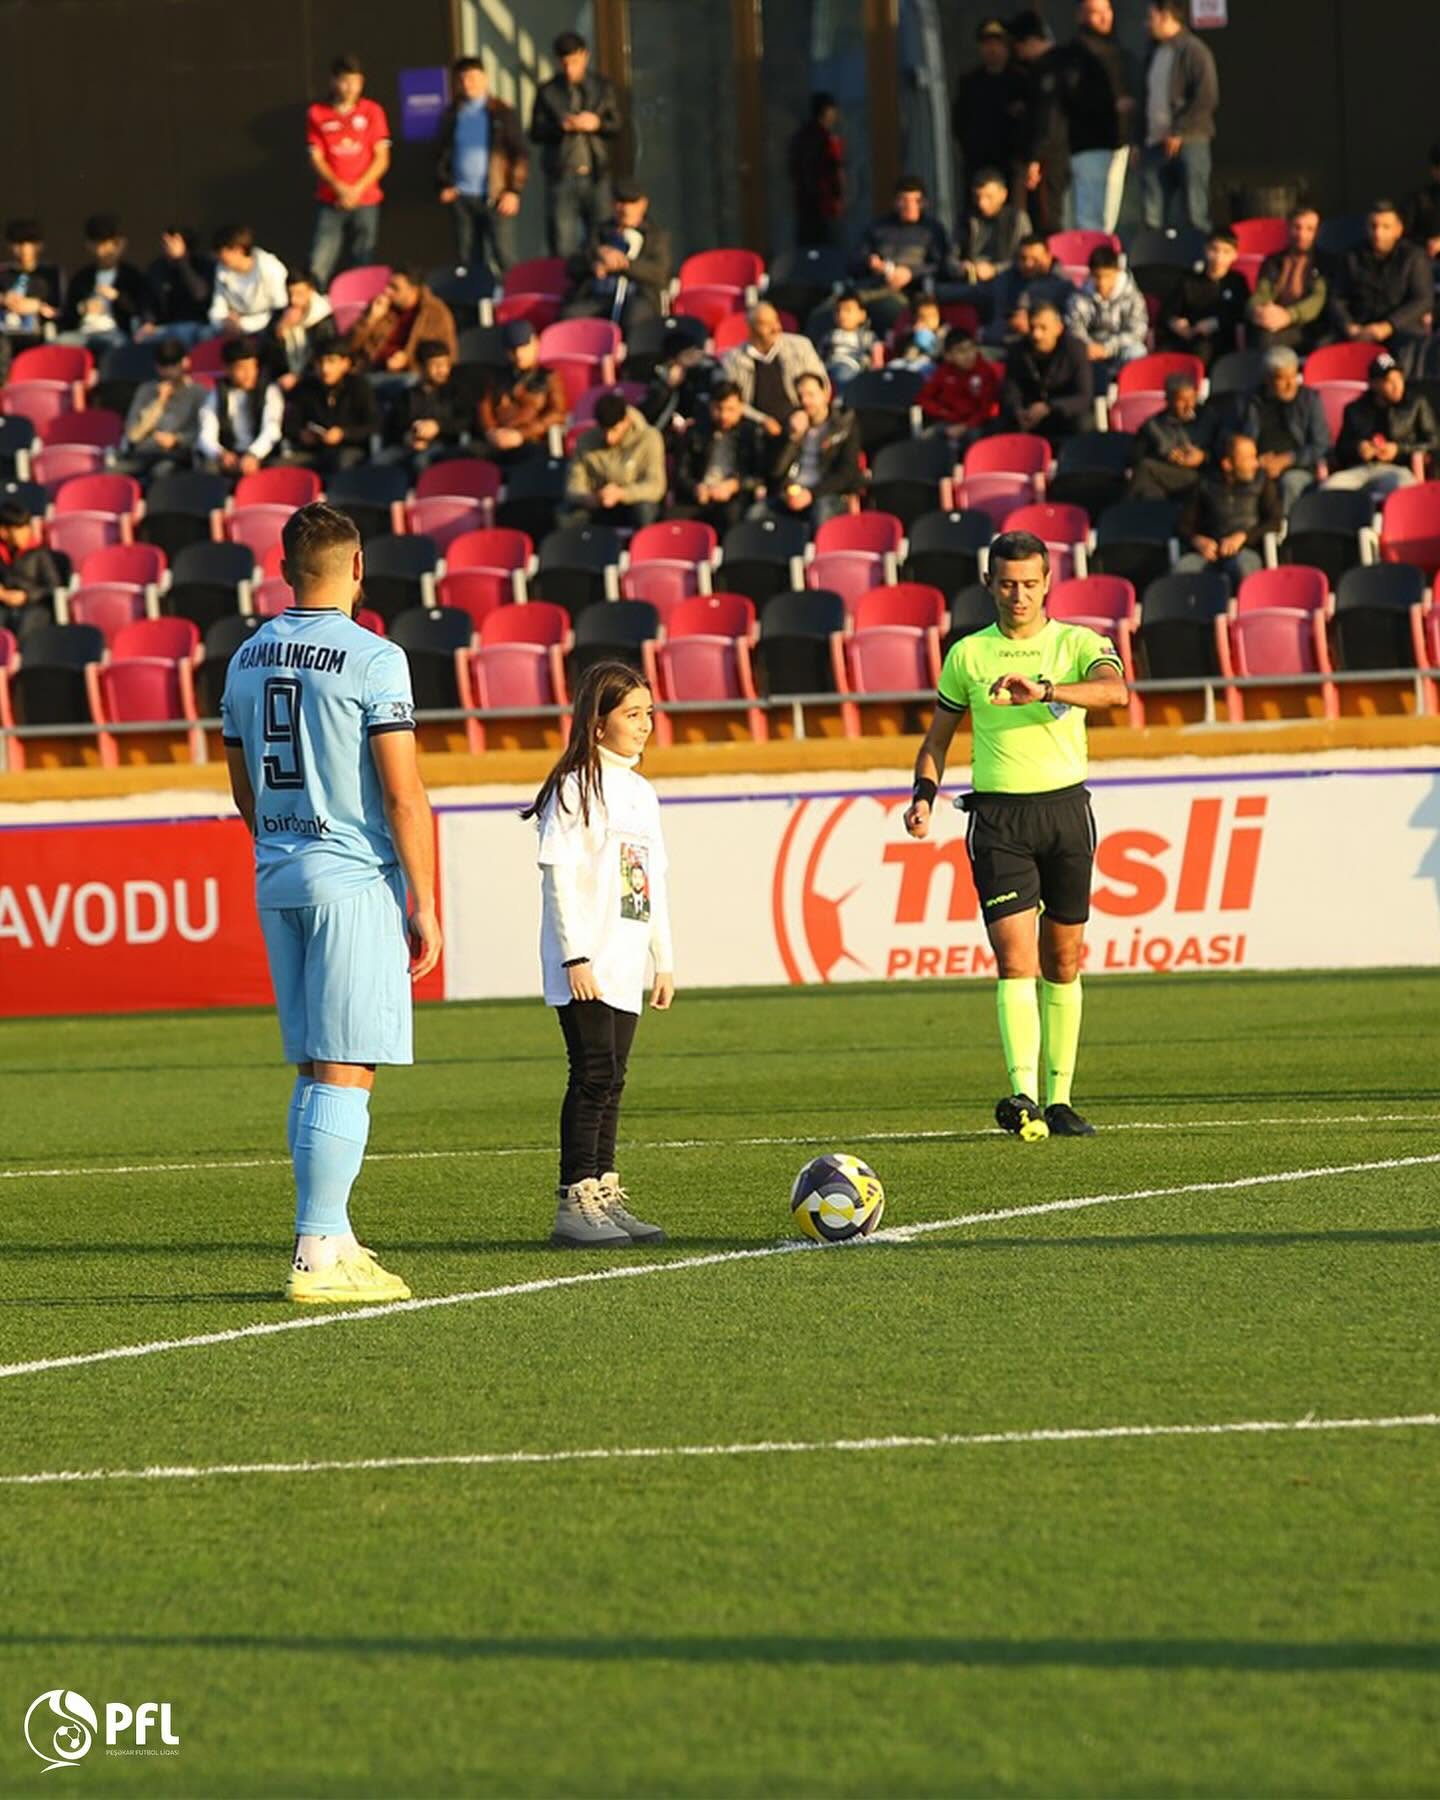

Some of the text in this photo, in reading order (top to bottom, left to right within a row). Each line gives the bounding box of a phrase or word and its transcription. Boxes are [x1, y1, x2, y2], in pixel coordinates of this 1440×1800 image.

[239, 641, 347, 675] RAMALINGOM
[263, 676, 305, 790] 9
[882, 795, 1268, 925] msli
[886, 928, 1246, 977] PREMR LİQASI
